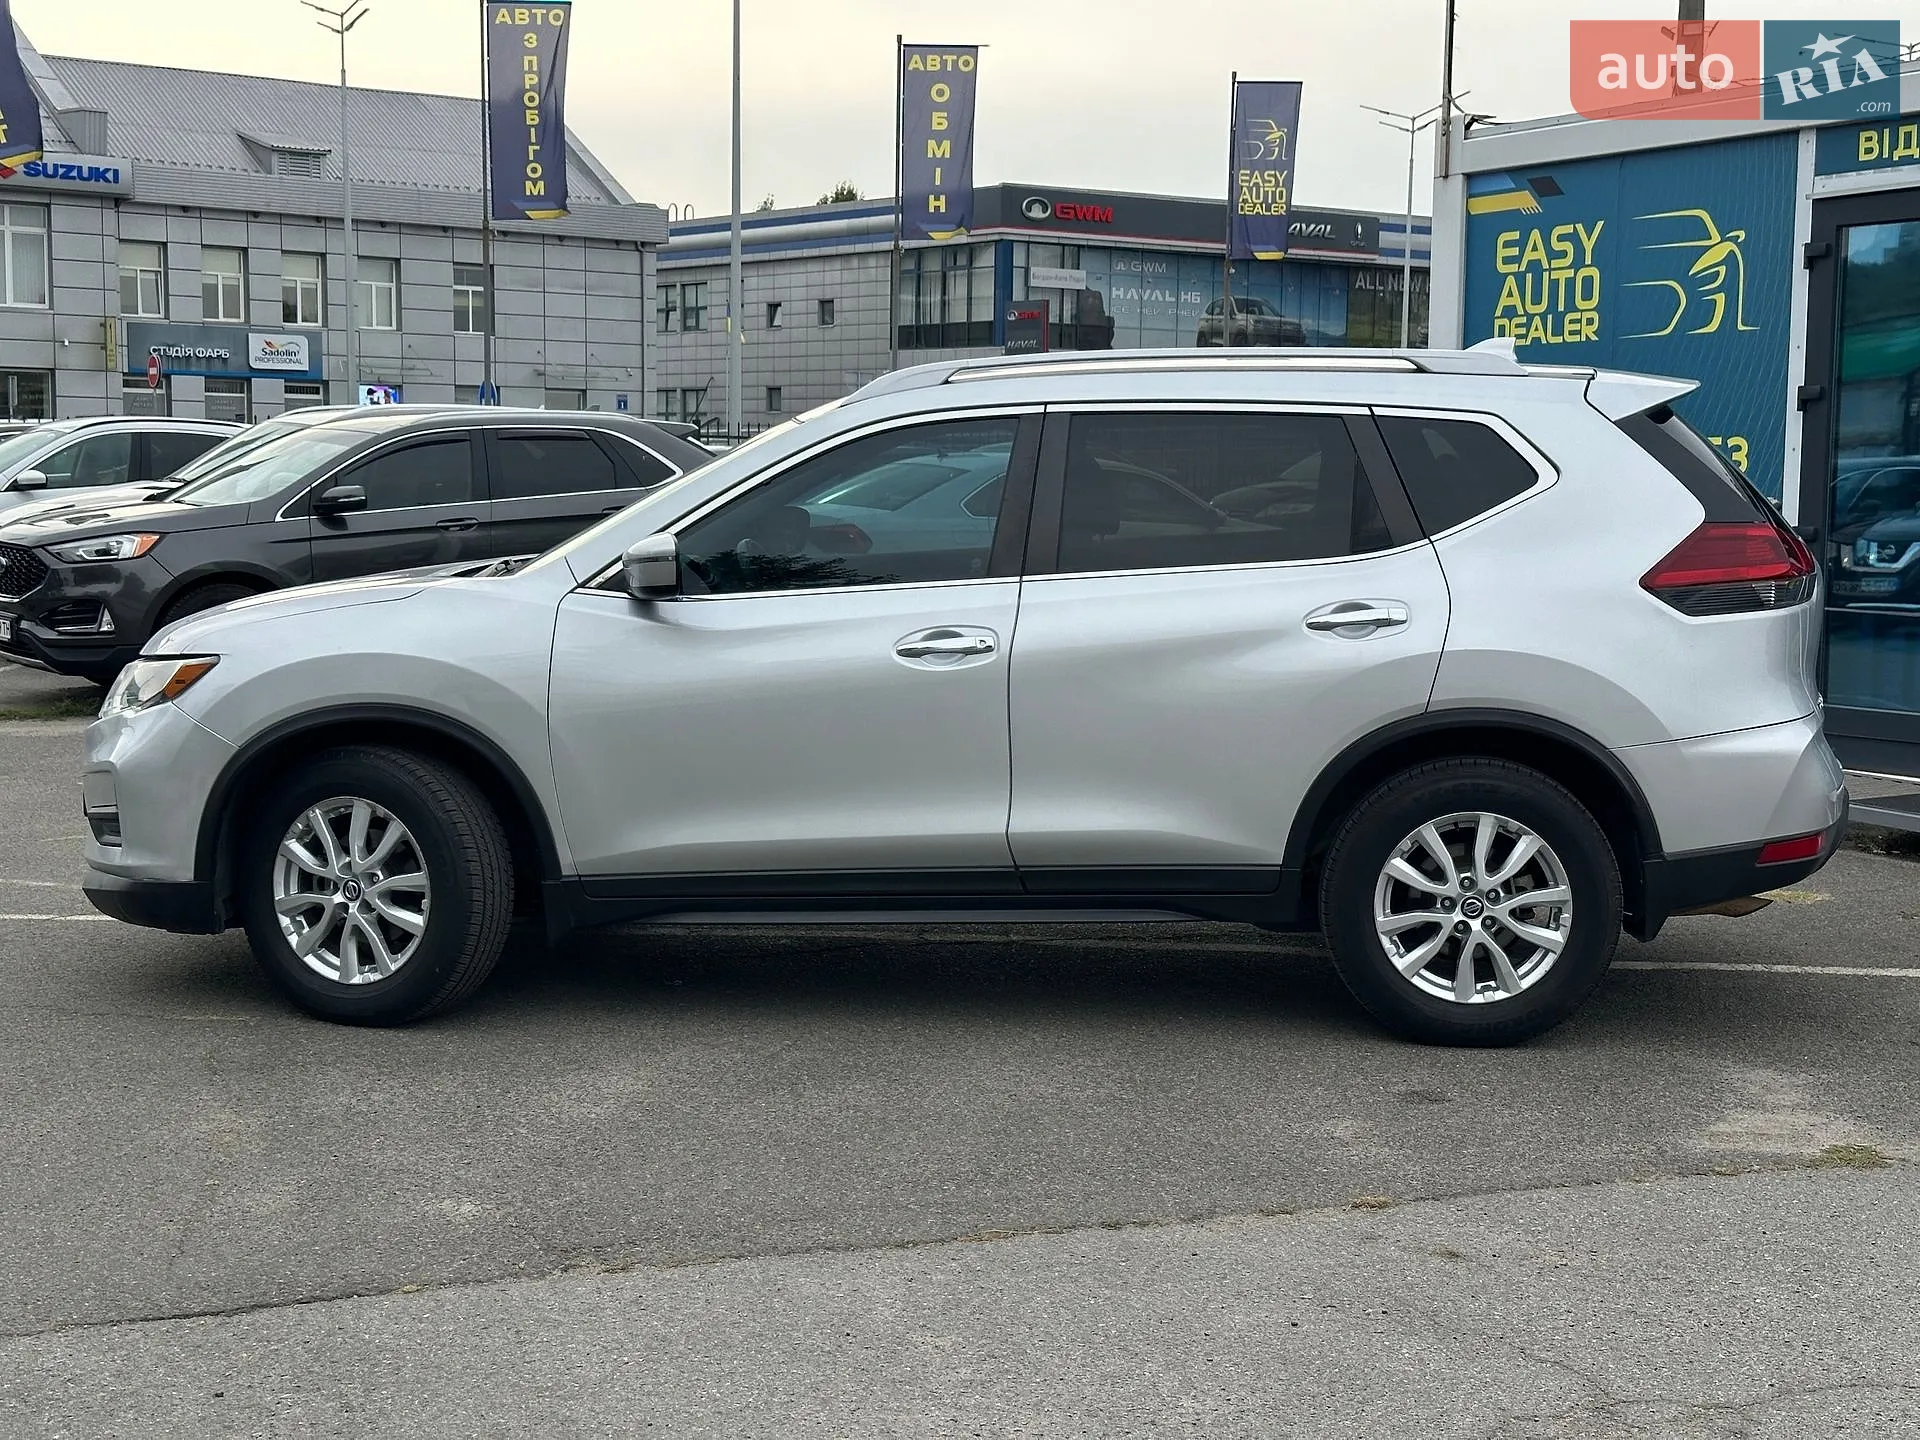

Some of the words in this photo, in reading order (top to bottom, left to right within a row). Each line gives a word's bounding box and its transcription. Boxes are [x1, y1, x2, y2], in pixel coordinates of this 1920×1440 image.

[495, 8, 565, 25] АВТО
[907, 54, 975, 72] АВТО
[523, 56, 545, 196] ПРОБІГОМ
[927, 83, 951, 213] ОБМІН
[23, 161, 119, 184] SUZUKI
[1238, 170, 1288, 187] EASY
[1239, 187, 1286, 203] AUTO
[1055, 203, 1113, 223] GWM
[1238, 203, 1286, 216] DEALER
[1287, 222, 1336, 239] AVAL
[1495, 220, 1604, 273] EASY
[1130, 261, 1167, 273] GWM
[1355, 271, 1384, 291] ALL
[1112, 287, 1176, 302] HAVAL
[1181, 291, 1201, 304] H6
[1494, 266, 1600, 317] AUTO
[1494, 310, 1599, 345] DEALER
[261, 347, 297, 358] Sadolin
[1007, 339, 1038, 349] HAVAL
[195, 347, 230, 359] ФАРБ
[254, 356, 304, 365] PROFESSIONAL
